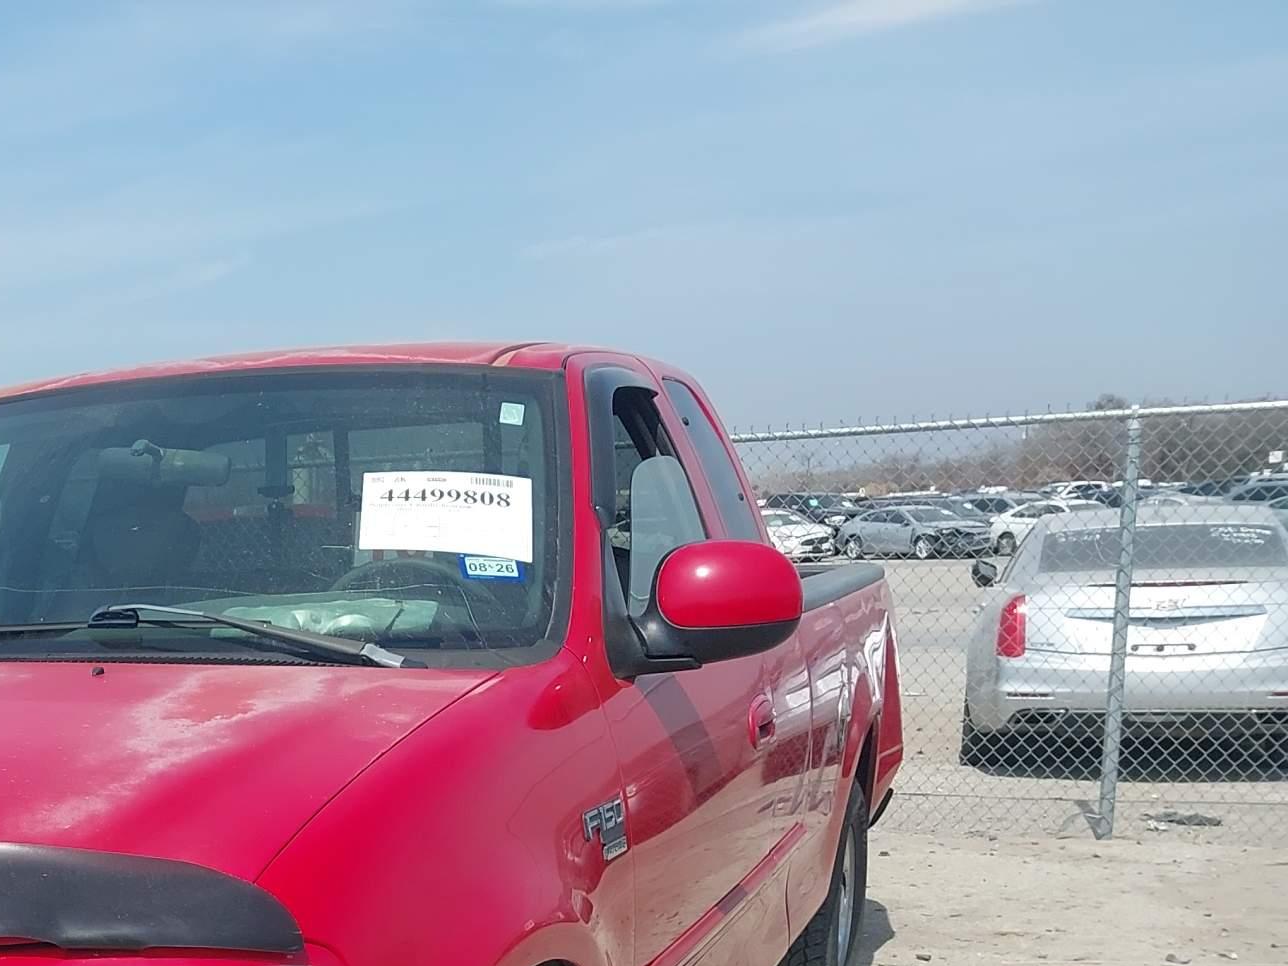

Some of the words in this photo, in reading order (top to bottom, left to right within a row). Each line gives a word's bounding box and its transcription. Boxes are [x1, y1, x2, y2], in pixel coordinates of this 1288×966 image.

[380, 488, 511, 508] 44499808
[468, 562, 488, 572] 08
[495, 563, 515, 574] 26
